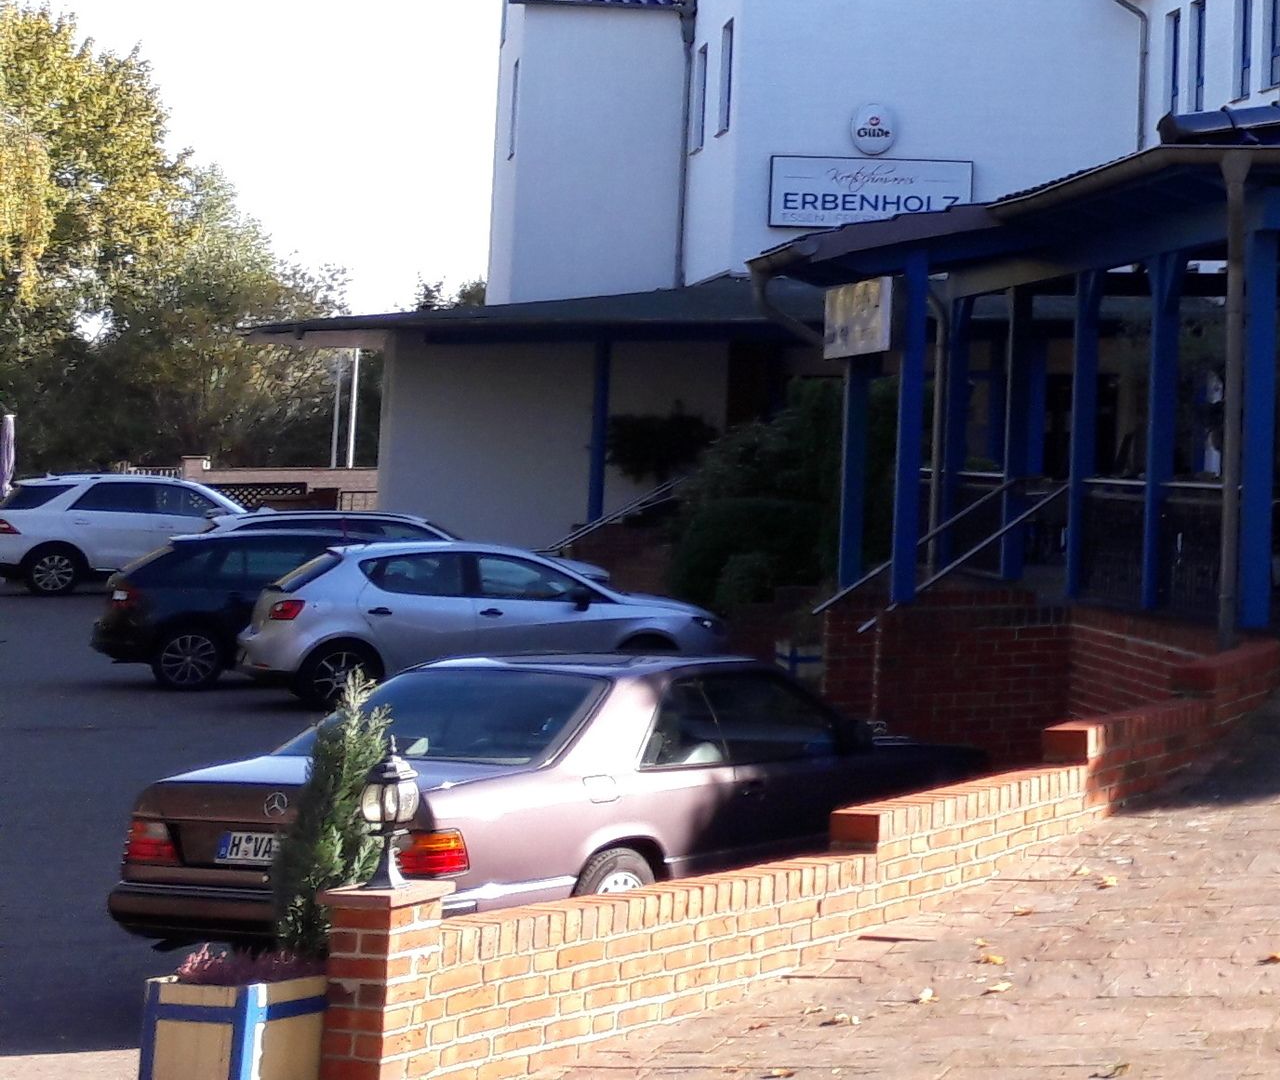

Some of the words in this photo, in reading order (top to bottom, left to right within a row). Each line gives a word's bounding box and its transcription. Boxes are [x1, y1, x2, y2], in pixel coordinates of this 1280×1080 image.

[857, 127, 890, 138] Gilde
[783, 192, 960, 212] ERBENHOLZ
[229, 836, 242, 856] H
